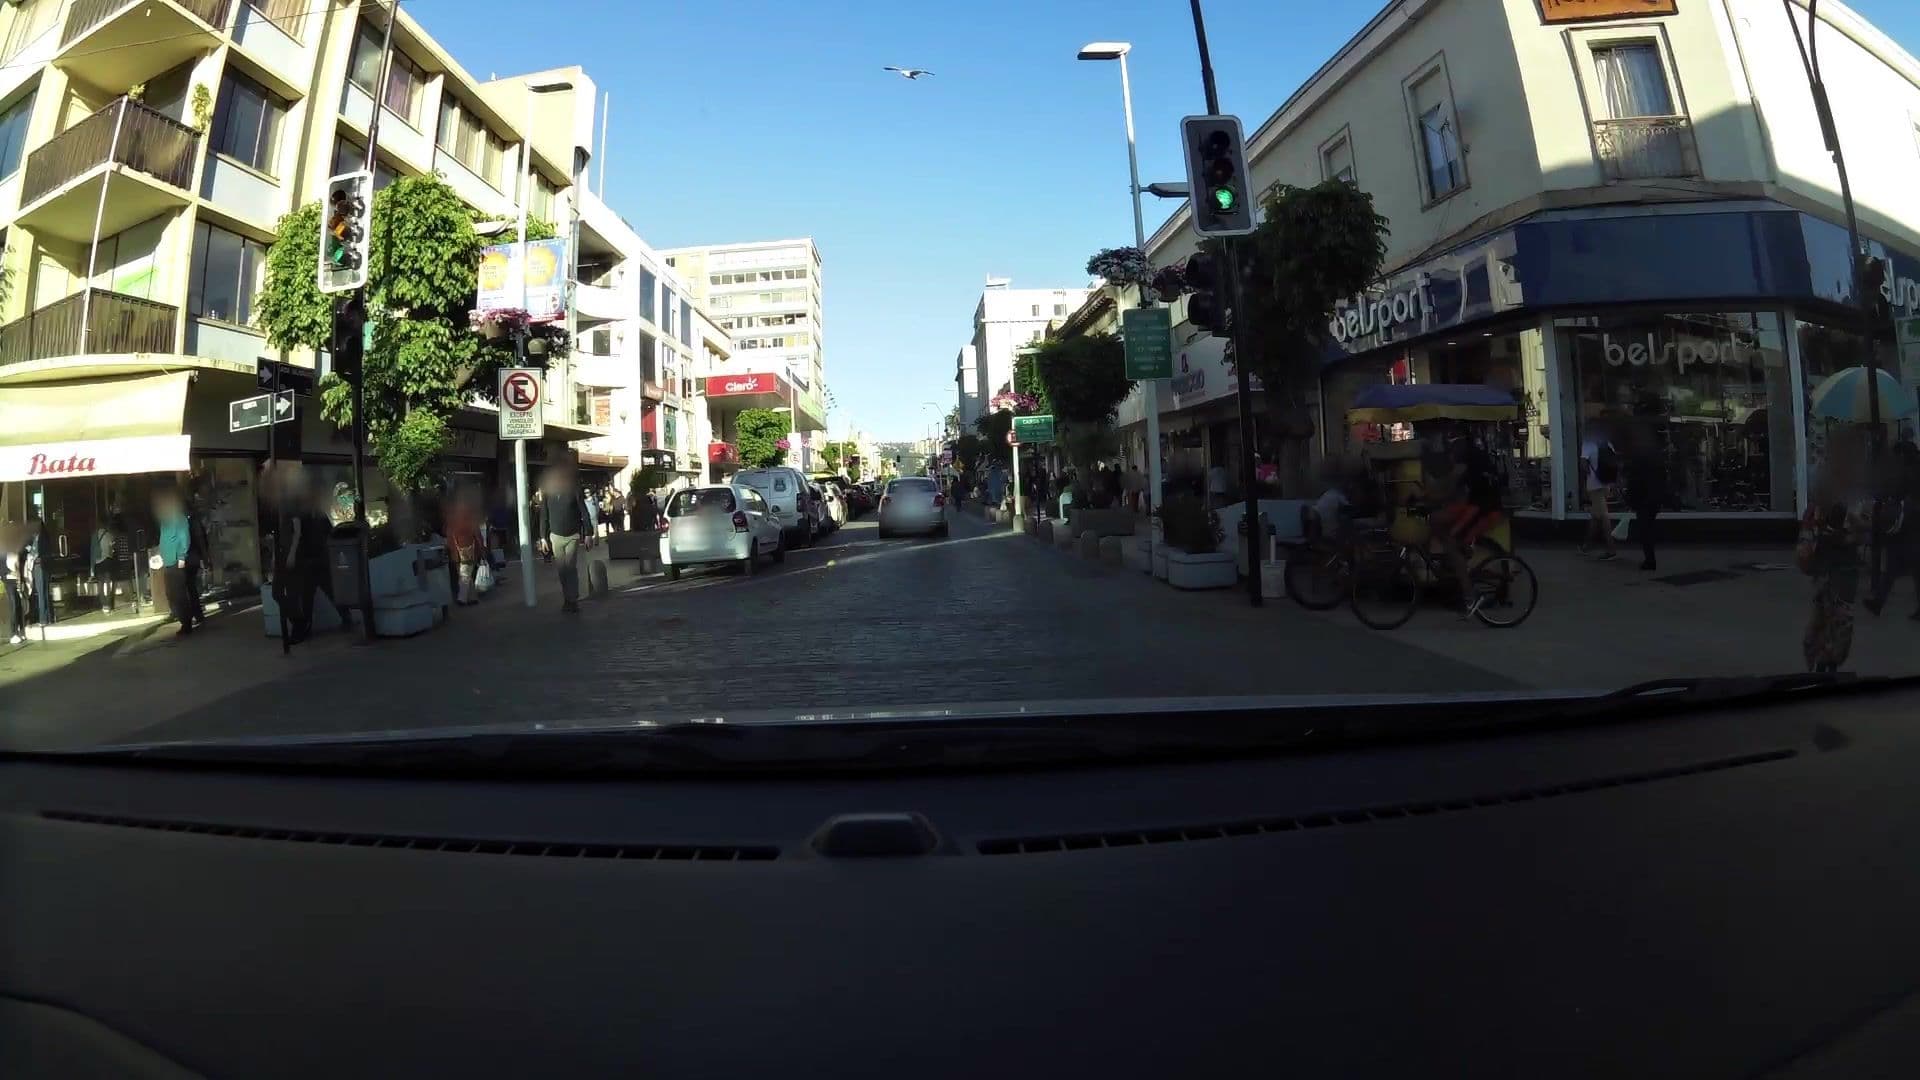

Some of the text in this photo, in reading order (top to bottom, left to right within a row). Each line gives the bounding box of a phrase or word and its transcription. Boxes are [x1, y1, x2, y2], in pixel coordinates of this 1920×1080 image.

[1328, 276, 1434, 343] belsport
[1603, 333, 1744, 375] belsport
[725, 379, 755, 392] Claro
[27, 451, 96, 475] Bata
